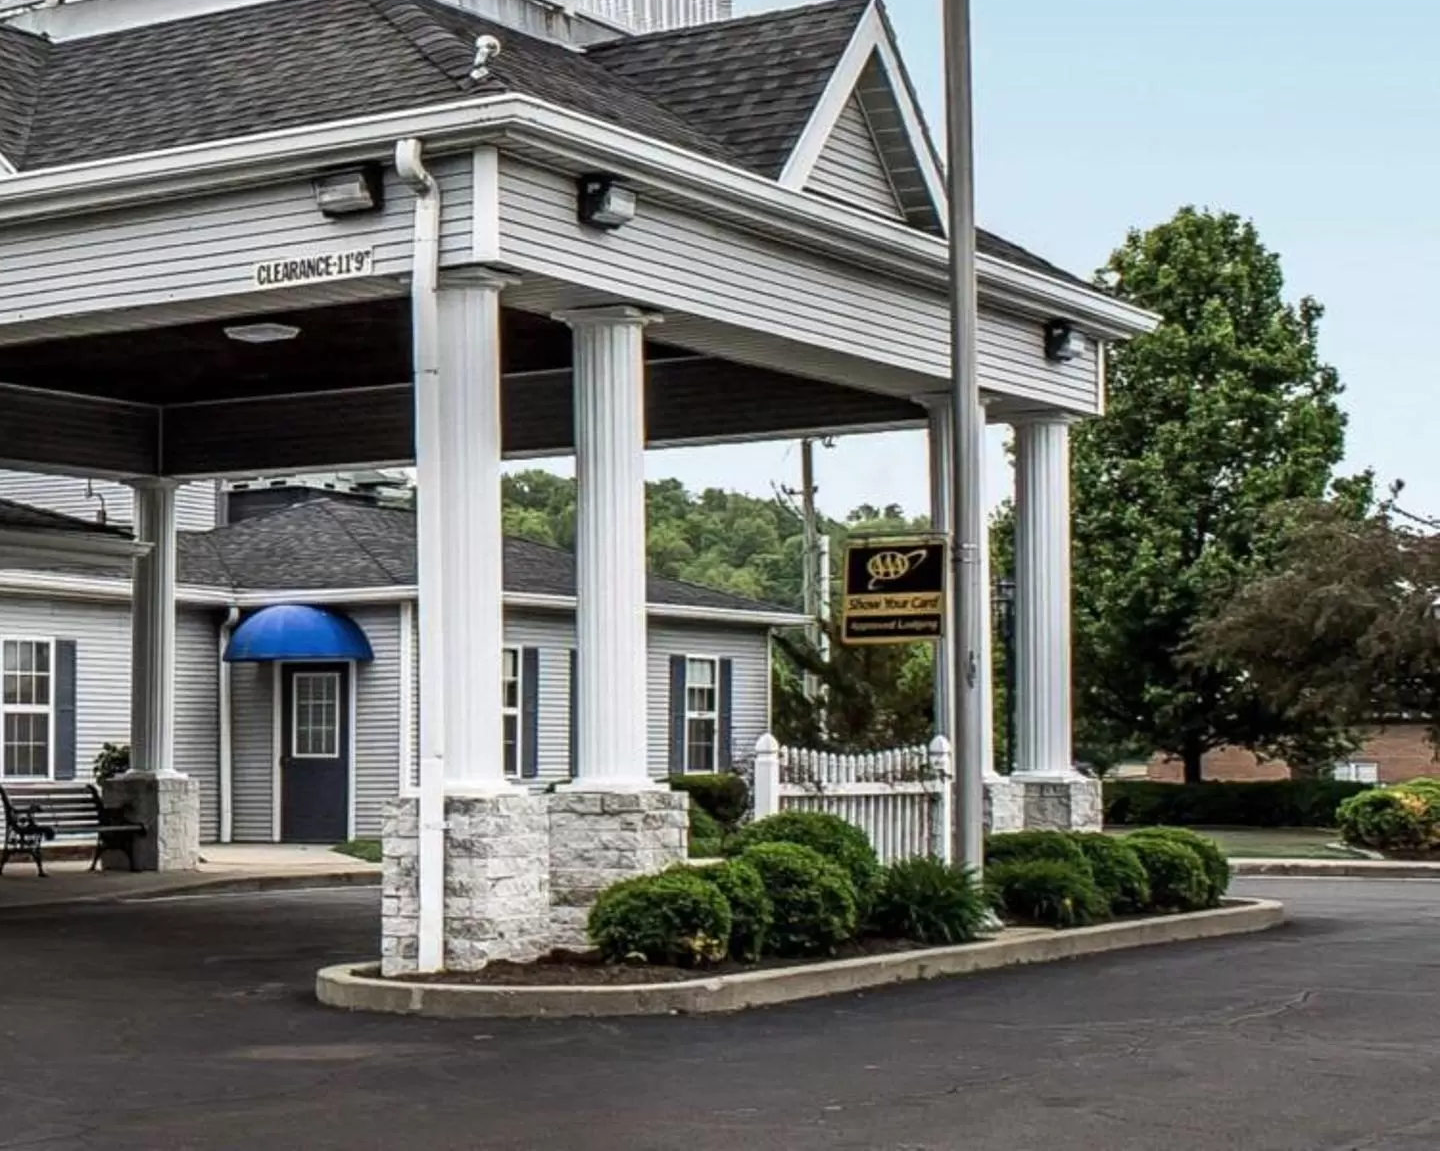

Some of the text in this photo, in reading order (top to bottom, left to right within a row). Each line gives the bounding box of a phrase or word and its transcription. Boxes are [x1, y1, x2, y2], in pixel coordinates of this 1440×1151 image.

[869, 551, 908, 579] AAA
[848, 595, 940, 610] Show Your Card
